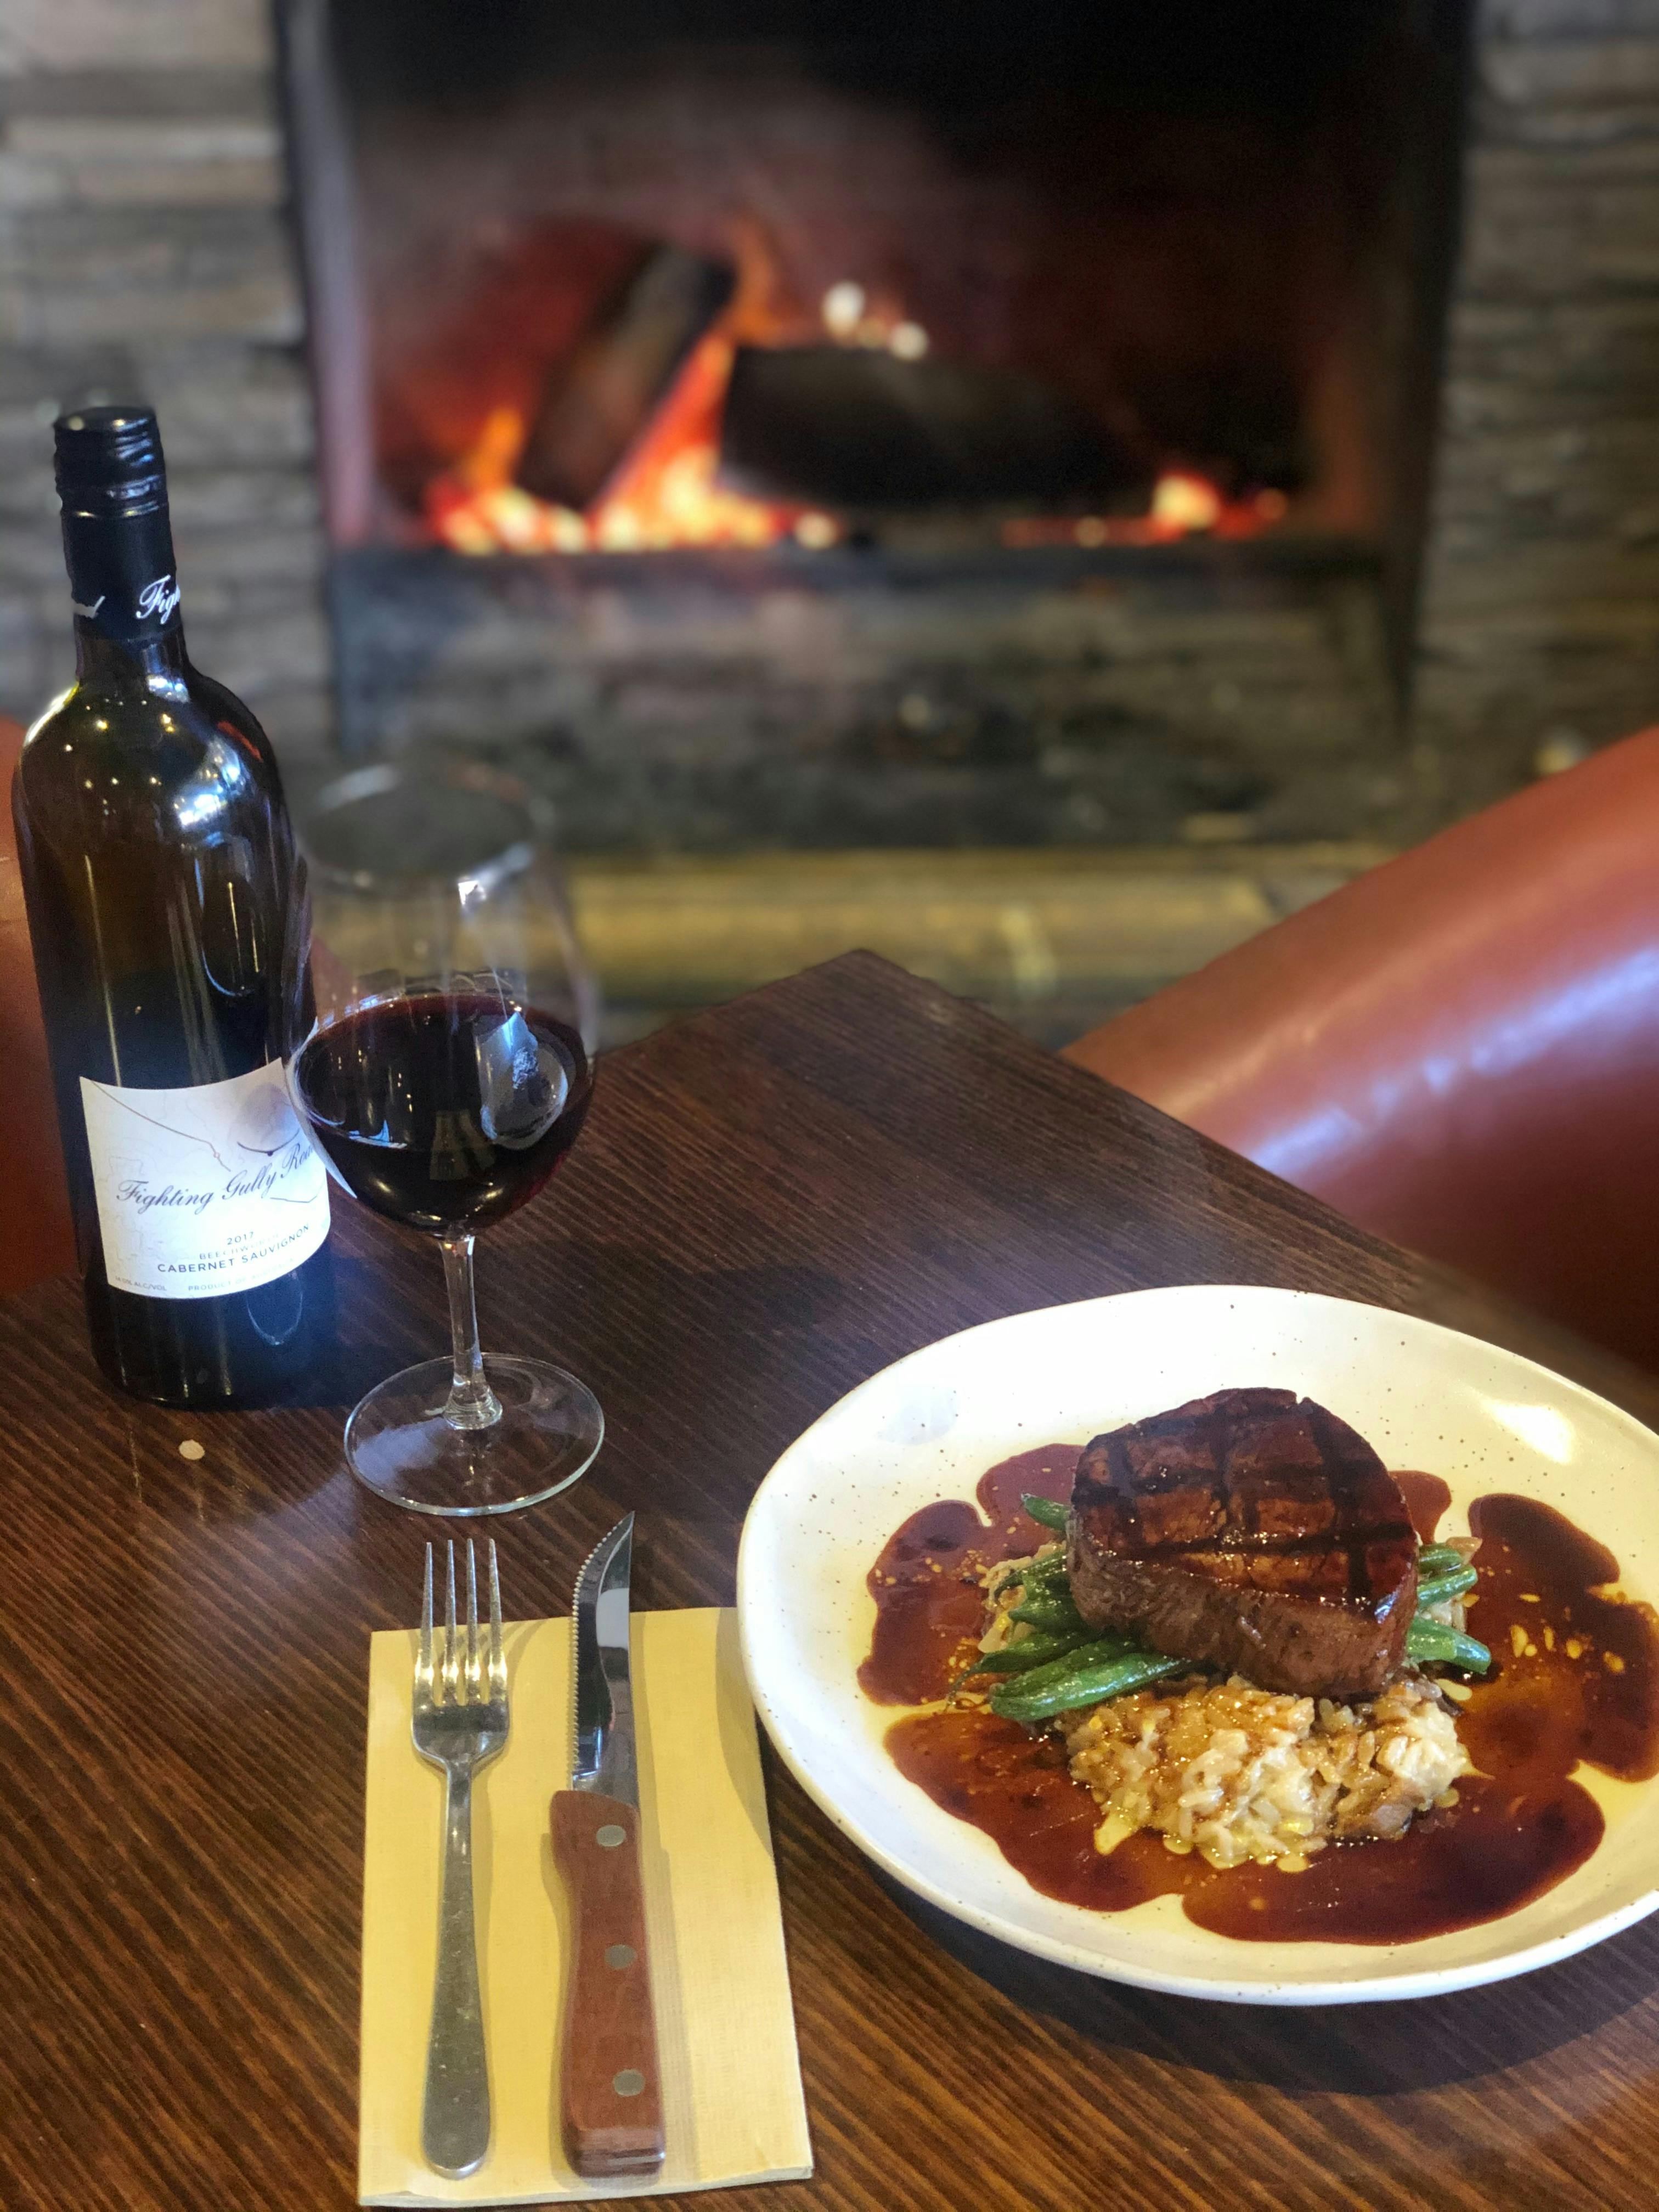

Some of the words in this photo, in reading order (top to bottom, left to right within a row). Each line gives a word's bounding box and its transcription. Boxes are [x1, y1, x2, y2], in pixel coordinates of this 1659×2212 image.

[116, 1179, 215, 1215] Fighting
[222, 1163, 277, 1200] Gully
[157, 1257, 235, 1273] CABERNET
[241, 1223, 309, 1263] SAUVIGNON
[227, 1231, 255, 1245] 2017
